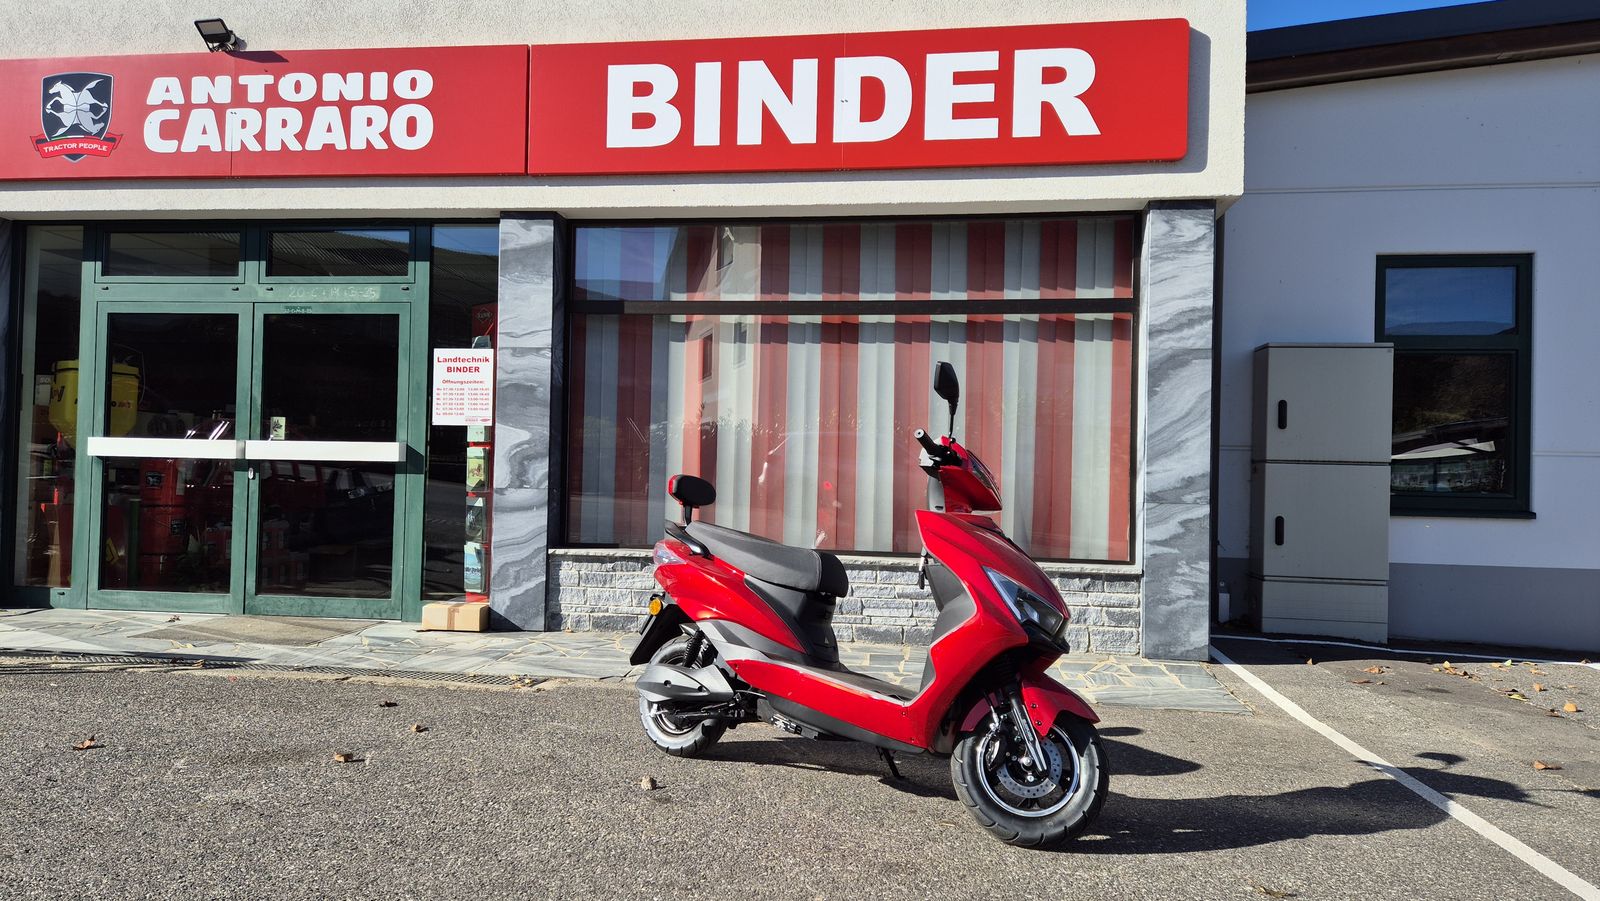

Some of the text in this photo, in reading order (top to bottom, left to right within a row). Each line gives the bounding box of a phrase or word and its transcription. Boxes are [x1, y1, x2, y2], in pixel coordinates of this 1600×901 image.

[146, 69, 434, 105] ANTONIO
[606, 47, 1101, 148] BINDER
[43, 142, 108, 153] TRACTOR PEOPLE
[143, 103, 434, 153] CARRARO
